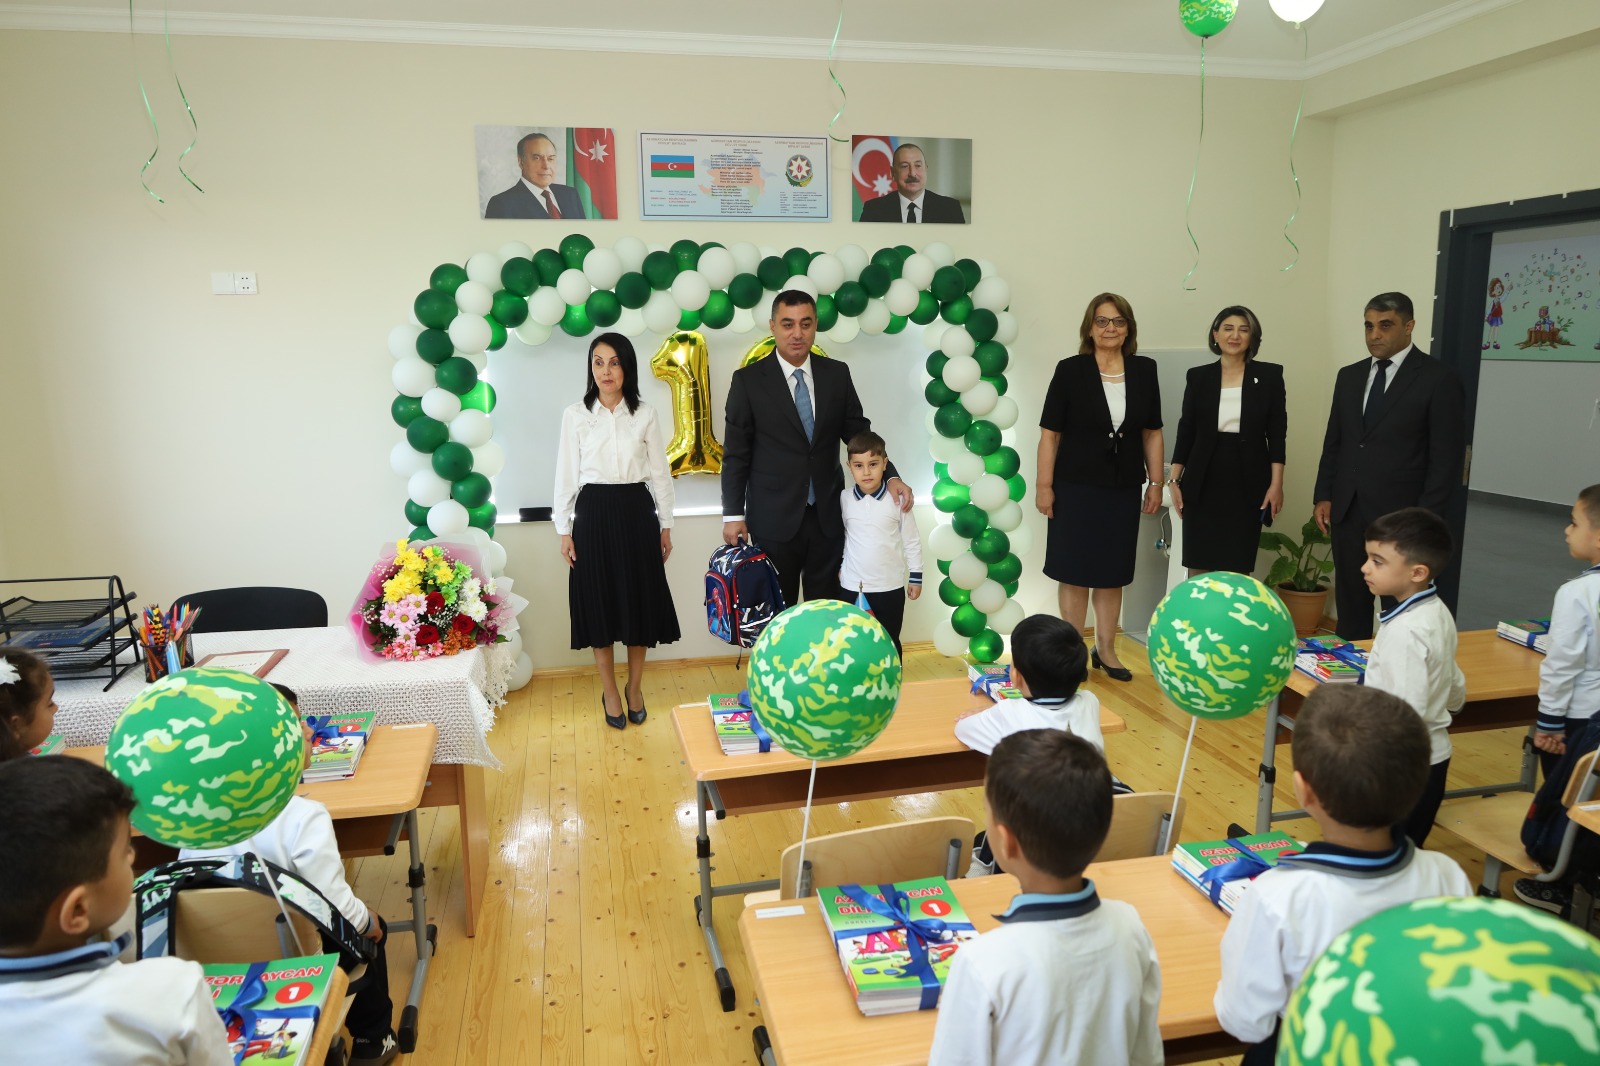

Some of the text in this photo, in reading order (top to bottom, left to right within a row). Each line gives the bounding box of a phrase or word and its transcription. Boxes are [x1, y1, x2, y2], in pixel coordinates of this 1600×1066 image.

[1199, 839, 1292, 856] AZƏRAYCAN
[928, 902, 942, 914] 1
[203, 966, 323, 986] ZƏRAYCAN
[288, 986, 300, 1000] 1
